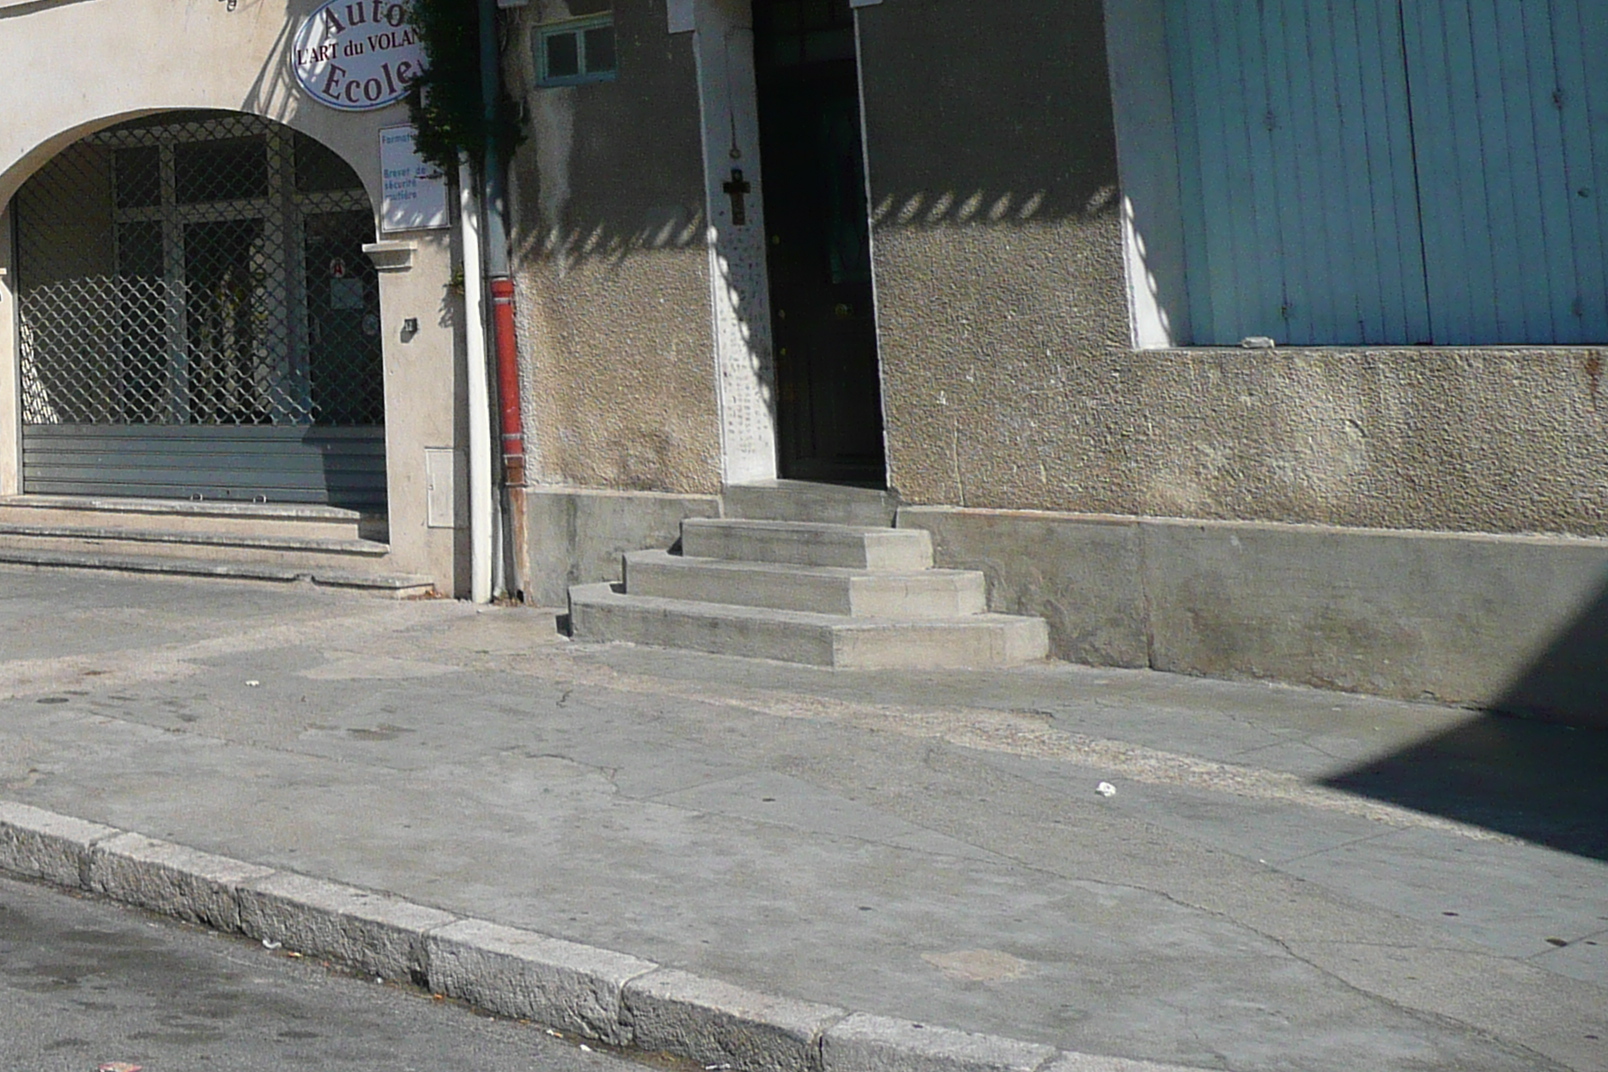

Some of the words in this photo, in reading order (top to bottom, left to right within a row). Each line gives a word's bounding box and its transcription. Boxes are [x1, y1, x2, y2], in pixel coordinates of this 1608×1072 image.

[297, 42, 339, 65] L'ART
[344, 40, 364, 57] du
[368, 27, 423, 52] VOLAN
[322, 61, 415, 103] Ecole
[382, 133, 411, 143] Format
